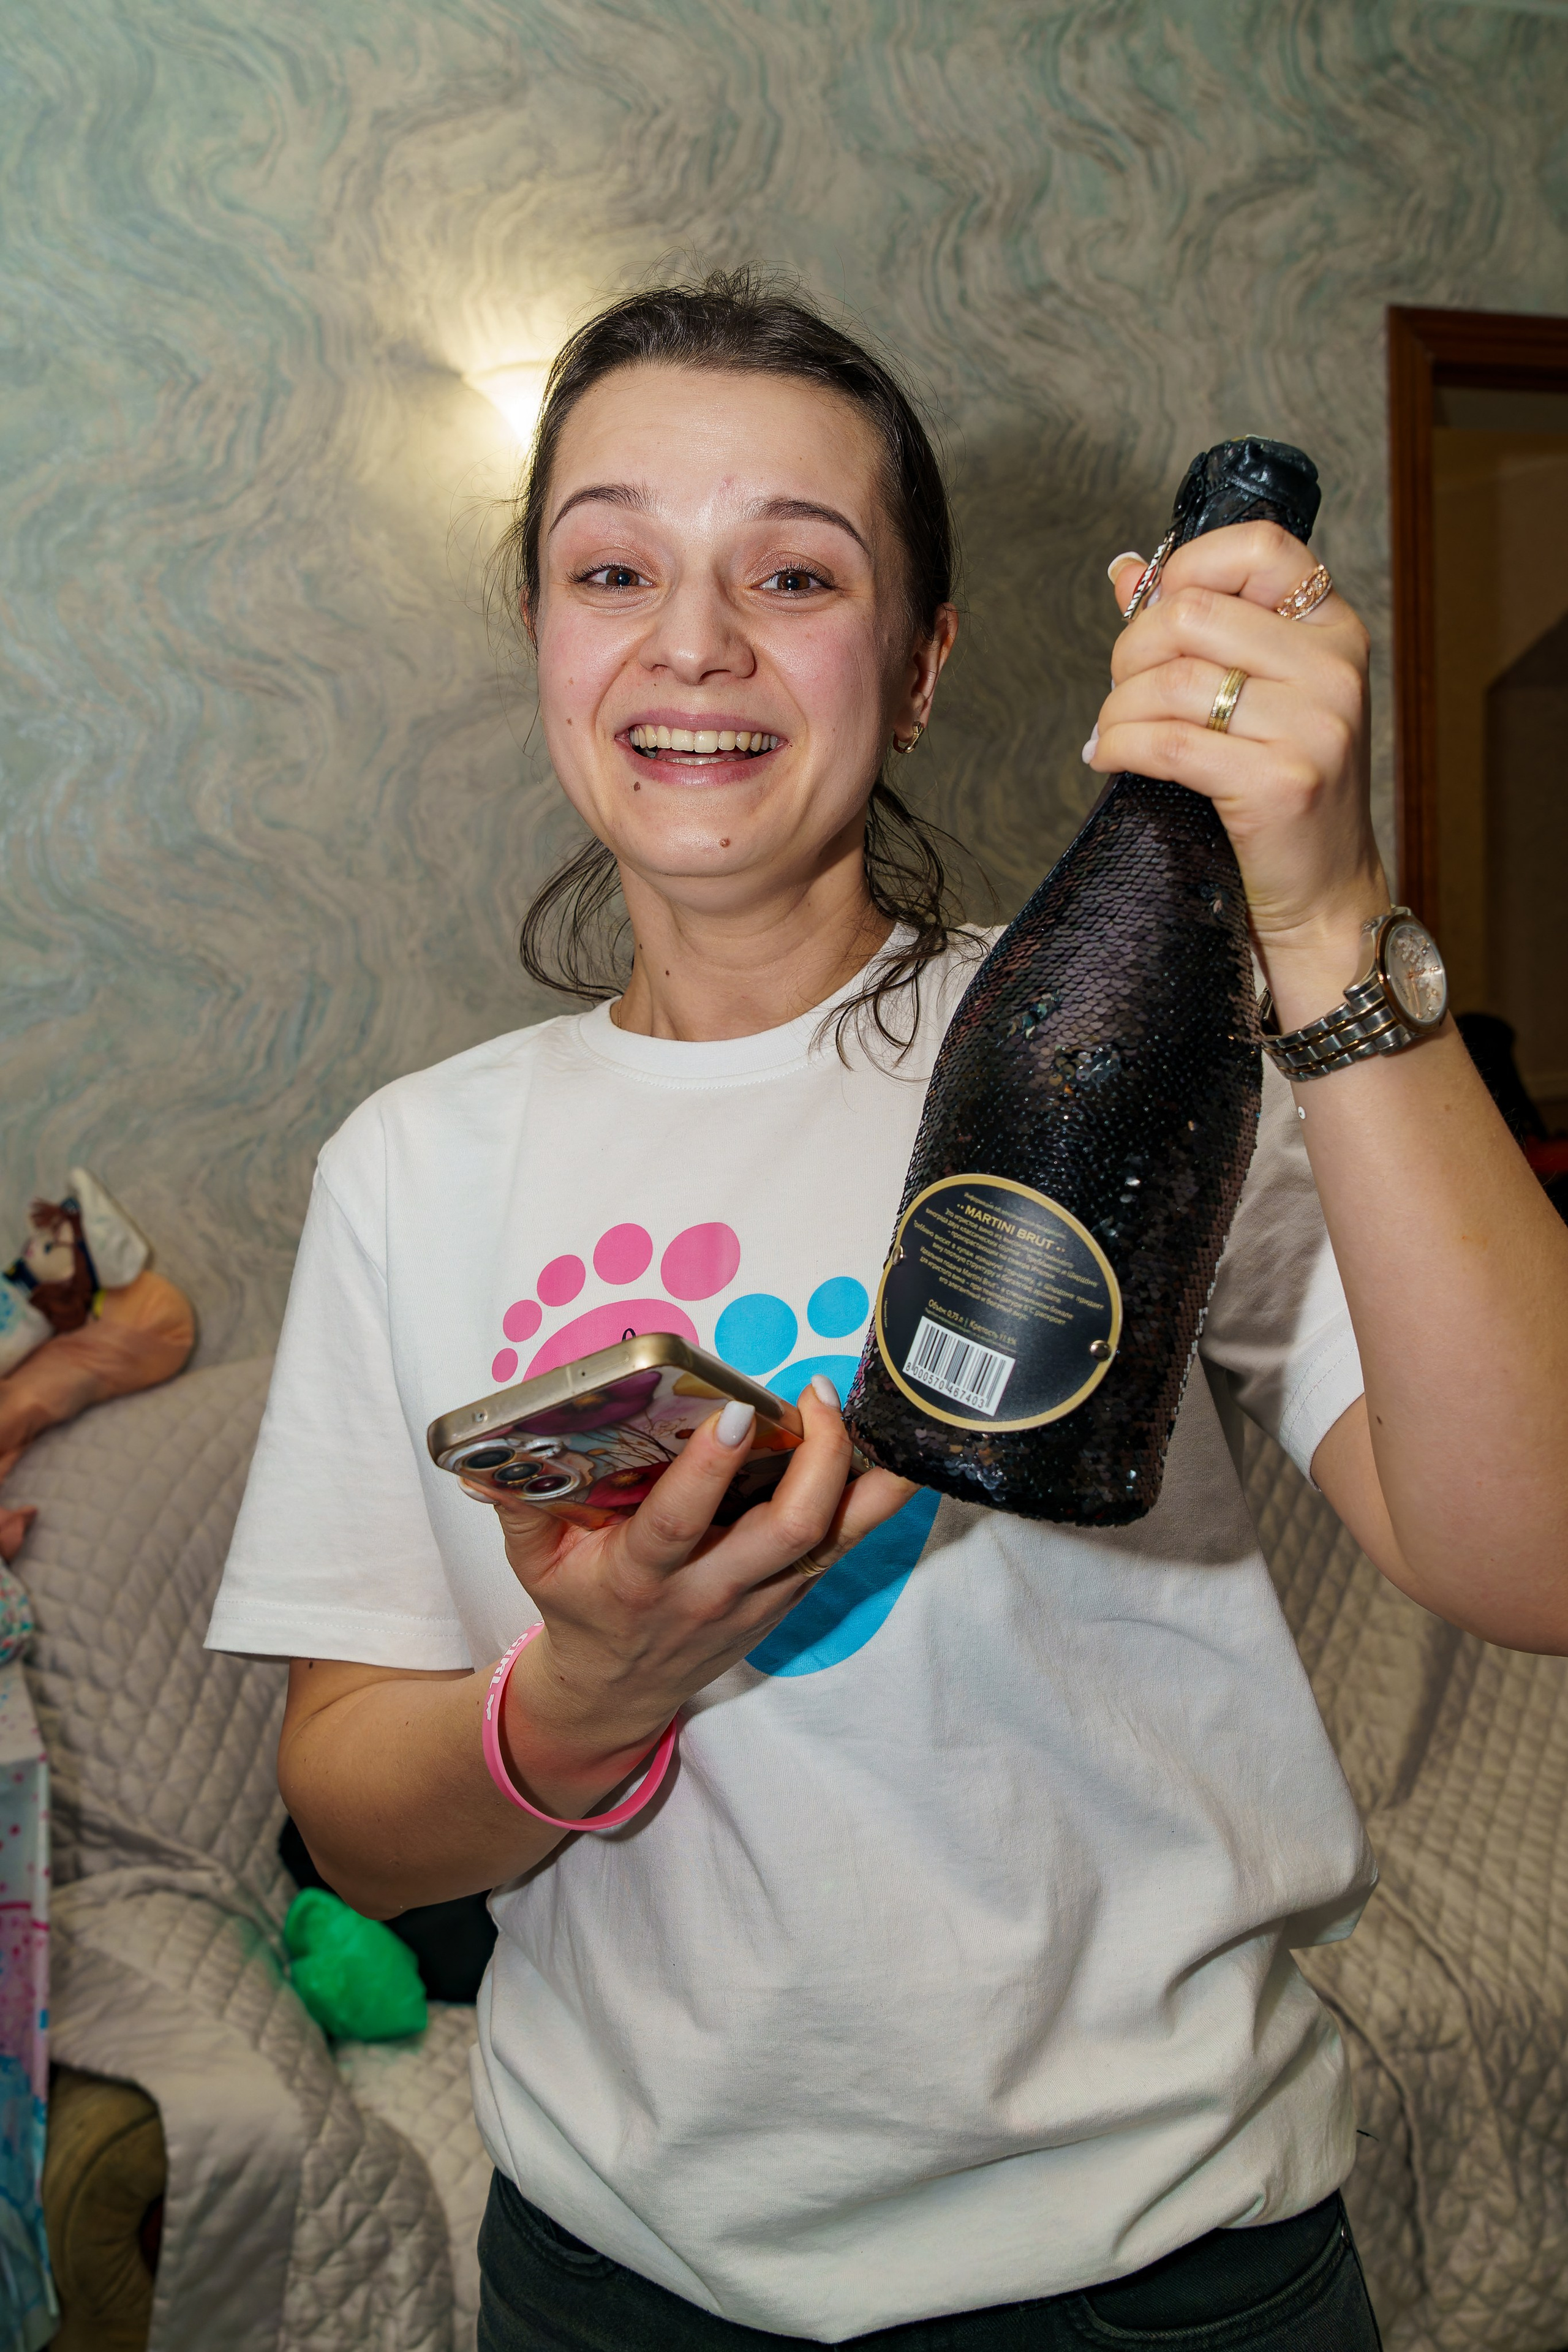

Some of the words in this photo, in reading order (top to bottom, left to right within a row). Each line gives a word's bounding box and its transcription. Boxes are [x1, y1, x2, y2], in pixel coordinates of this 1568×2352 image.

[965, 1205, 1015, 1234] MARTINI
[1016, 1227, 1054, 1250] BRUT
[913, 1367, 944, 1389] 000570
[947, 1385, 984, 1408] 467403
[489, 1633, 528, 1689] GIRL
